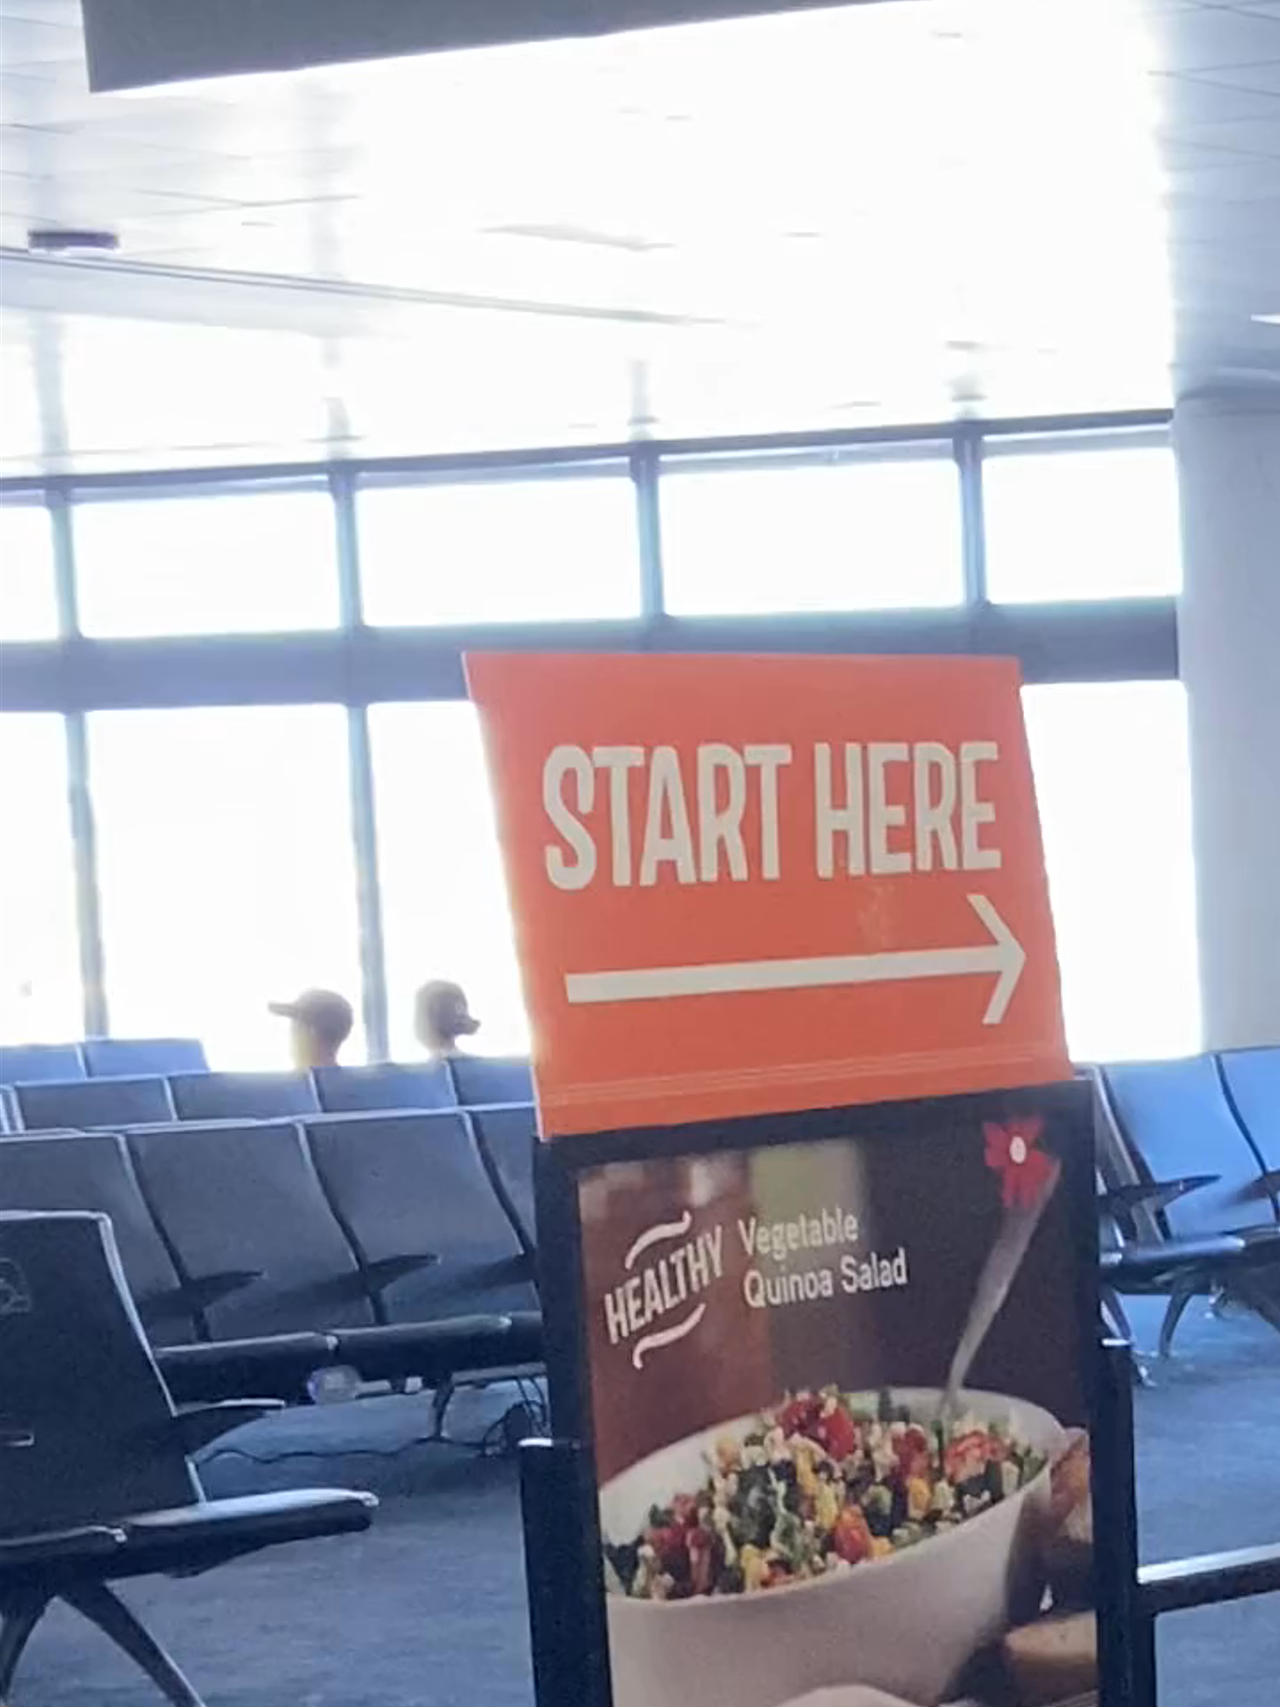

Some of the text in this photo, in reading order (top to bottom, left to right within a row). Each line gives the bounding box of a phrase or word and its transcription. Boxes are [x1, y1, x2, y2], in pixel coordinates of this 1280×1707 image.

[542, 741, 1002, 890] START HERE
[738, 1206, 860, 1261] Vegetable
[743, 1247, 909, 1309] Quinoa Salad
[604, 1224, 723, 1344] HEALTHY
